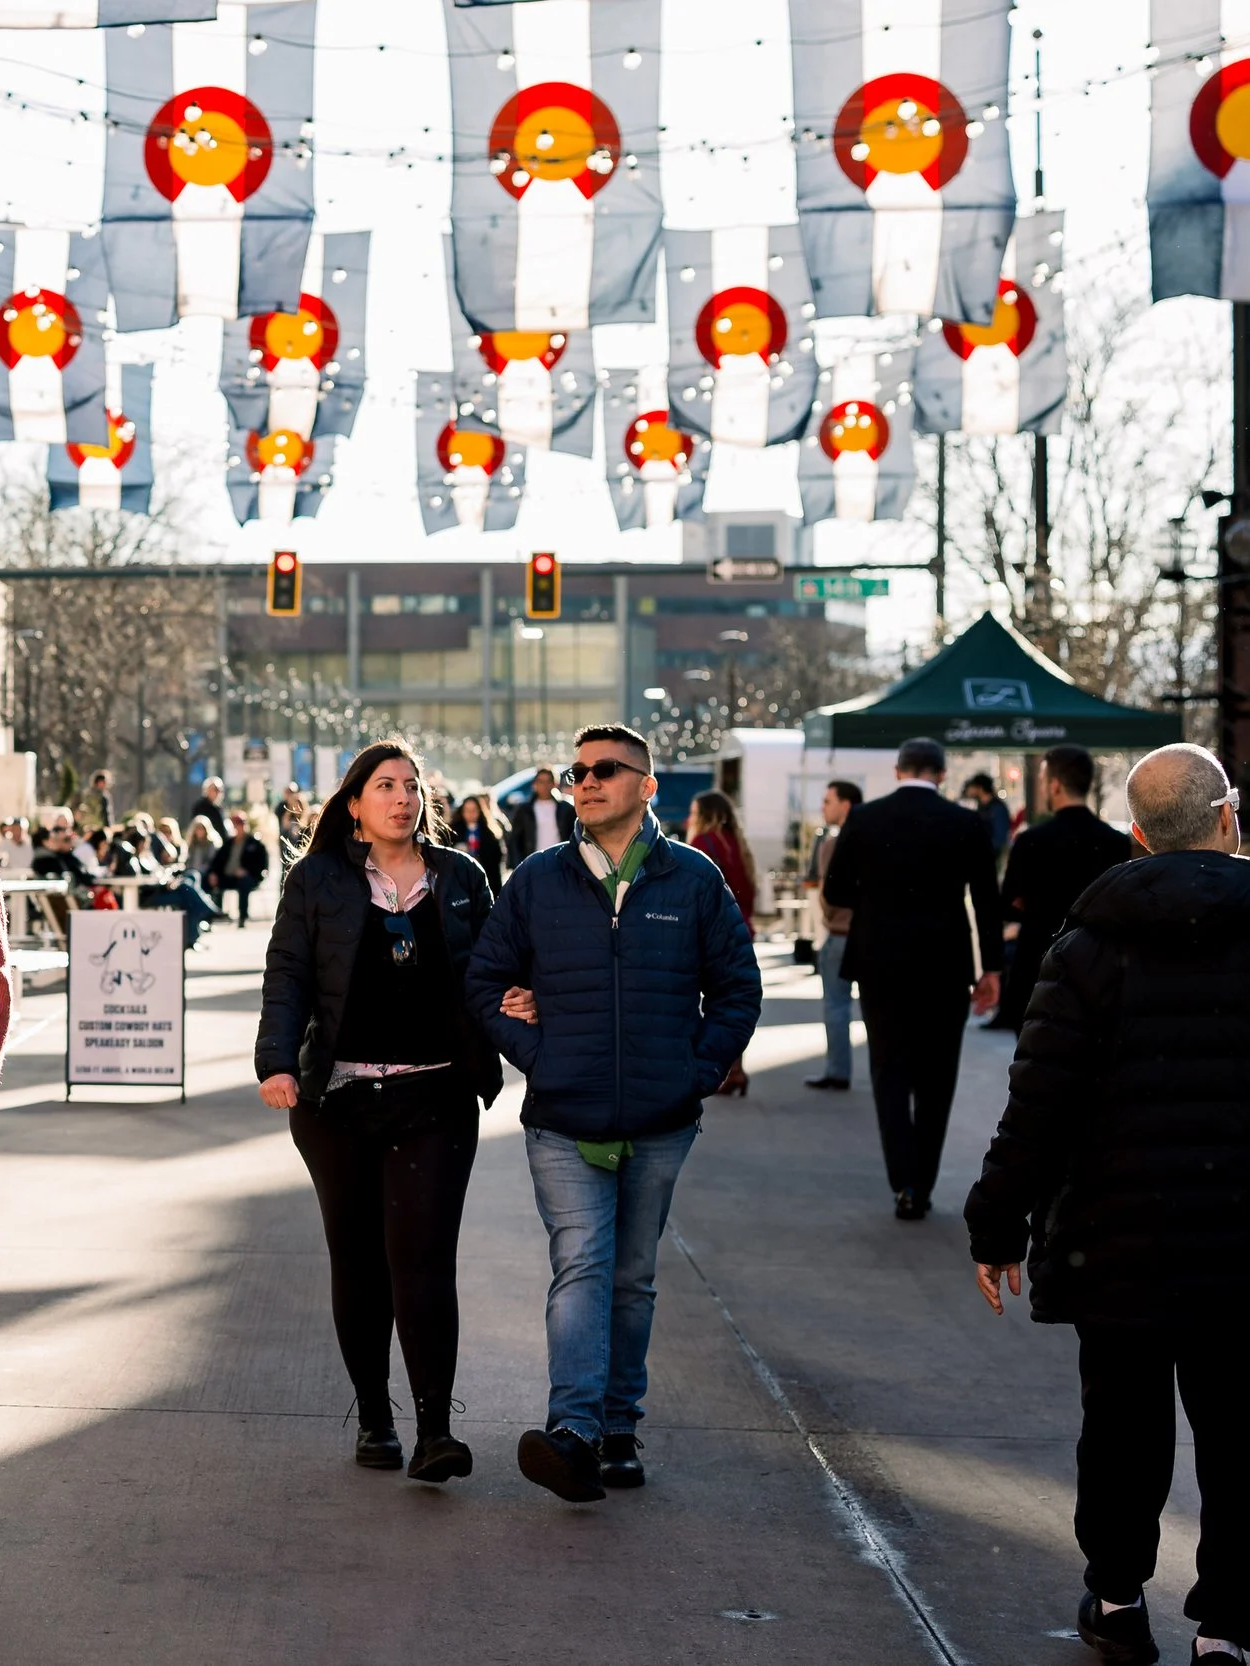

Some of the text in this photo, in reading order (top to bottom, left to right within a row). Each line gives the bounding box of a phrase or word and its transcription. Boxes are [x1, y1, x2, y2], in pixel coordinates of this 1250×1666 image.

[651, 912, 679, 922] Columbia
[104, 1004, 147, 1014] COCKTAILS
[79, 1021, 172, 1031] CUSTOM COWBOY HATS
[85, 1038, 164, 1048] SPEAKEASY SALOON
